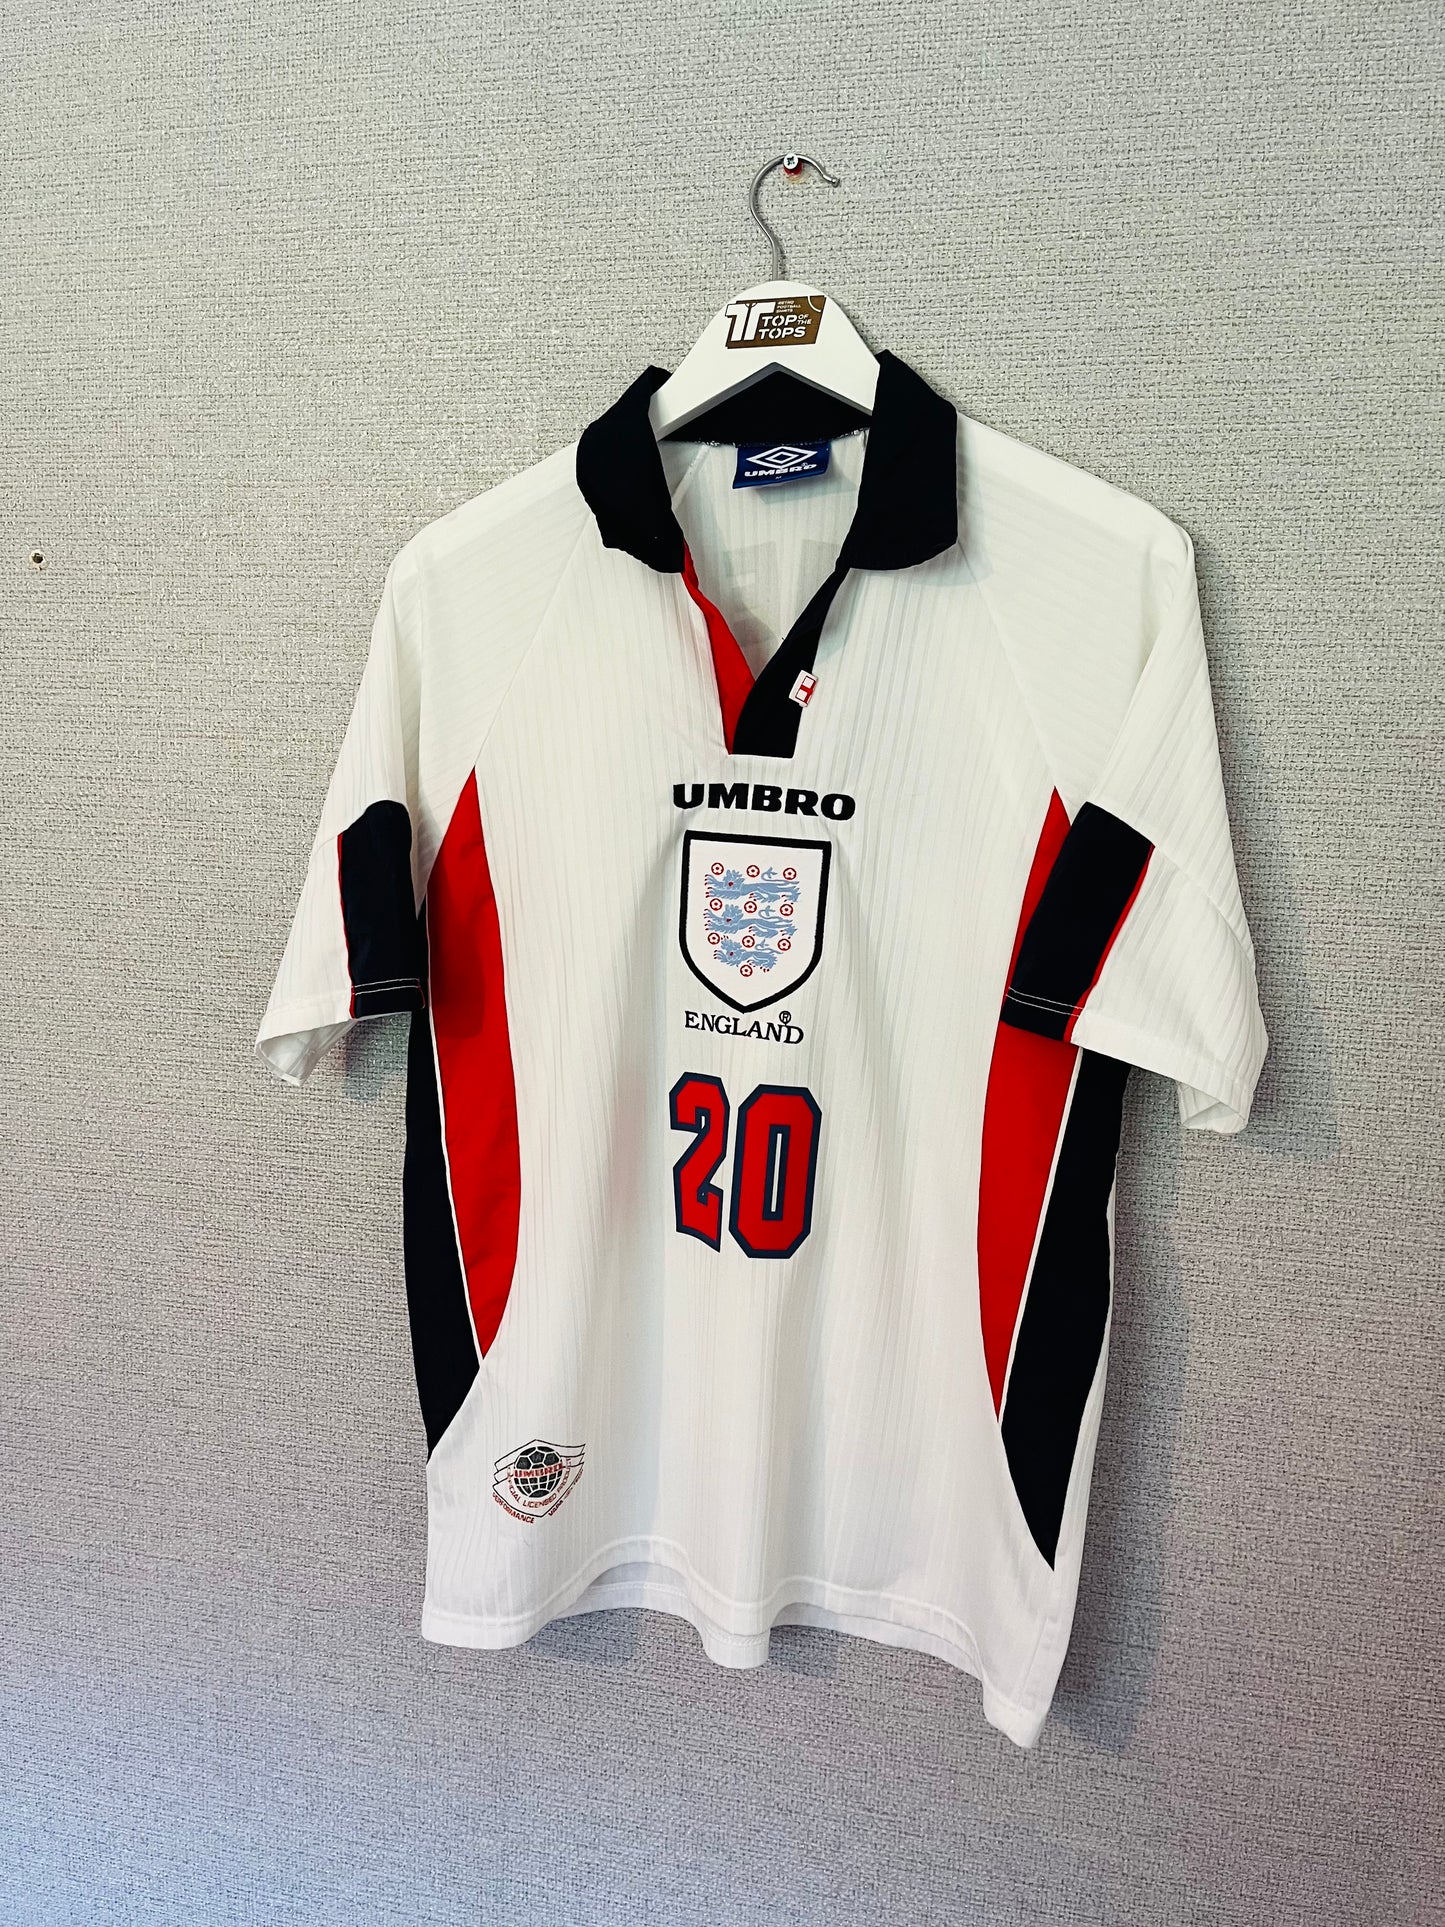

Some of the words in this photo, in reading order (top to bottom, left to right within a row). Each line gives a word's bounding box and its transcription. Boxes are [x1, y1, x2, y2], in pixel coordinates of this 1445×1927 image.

[761, 314, 798, 328] TOP
[797, 318, 812, 326] THE
[798, 313, 809, 321] OF
[758, 326, 806, 340] TOPS
[744, 464, 817, 478] UMBRO
[673, 783, 856, 821] UMBRO
[684, 1010, 804, 1045] ENGLAND
[669, 1071, 823, 1260] 20
[513, 1462, 564, 1478] UMBRO
[492, 1492, 535, 1524] PERFORMANCE
[522, 1492, 557, 1509] LICENSED
